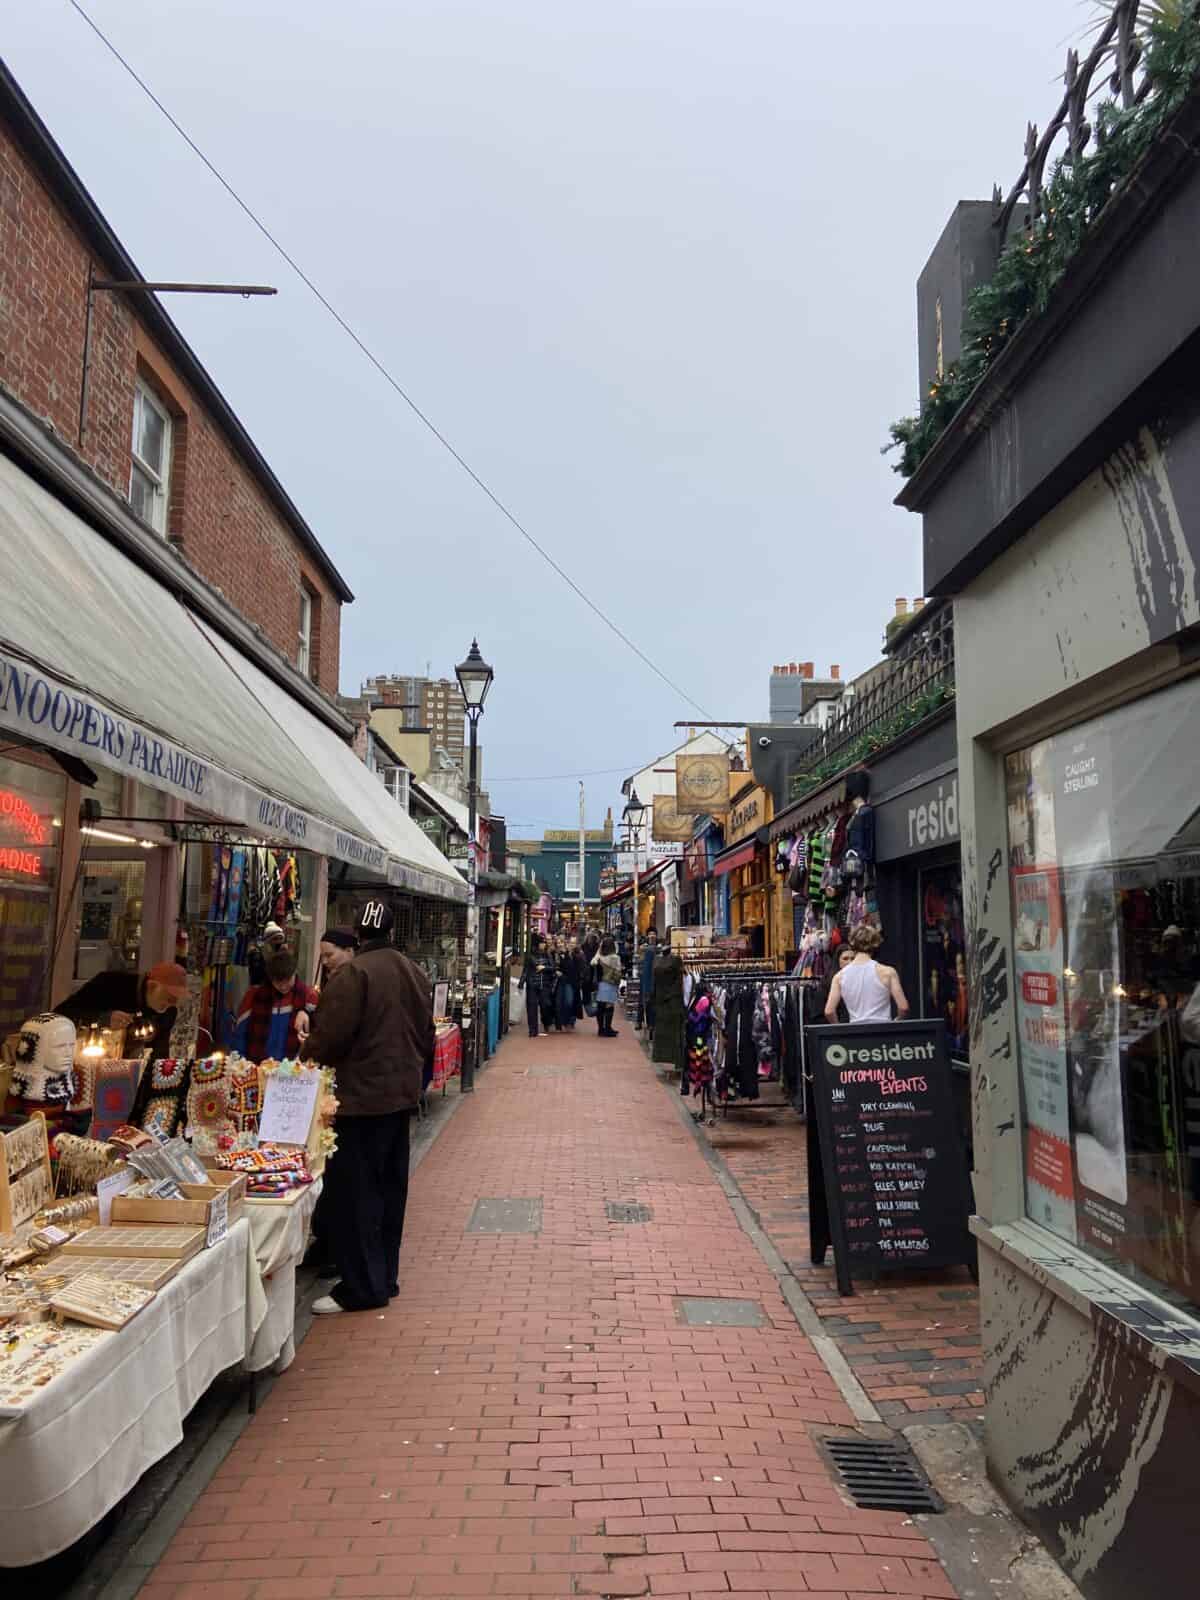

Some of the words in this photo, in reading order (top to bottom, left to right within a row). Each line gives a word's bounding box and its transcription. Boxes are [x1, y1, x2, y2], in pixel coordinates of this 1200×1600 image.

[128, 729, 208, 795] PARADISE
[908, 779, 958, 848] resid
[848, 1041, 935, 1063] resident
[840, 1067, 896, 1084] UPCOMING
[880, 1076, 928, 1095] EVENTS
[898, 1180, 925, 1191] BAILEY
